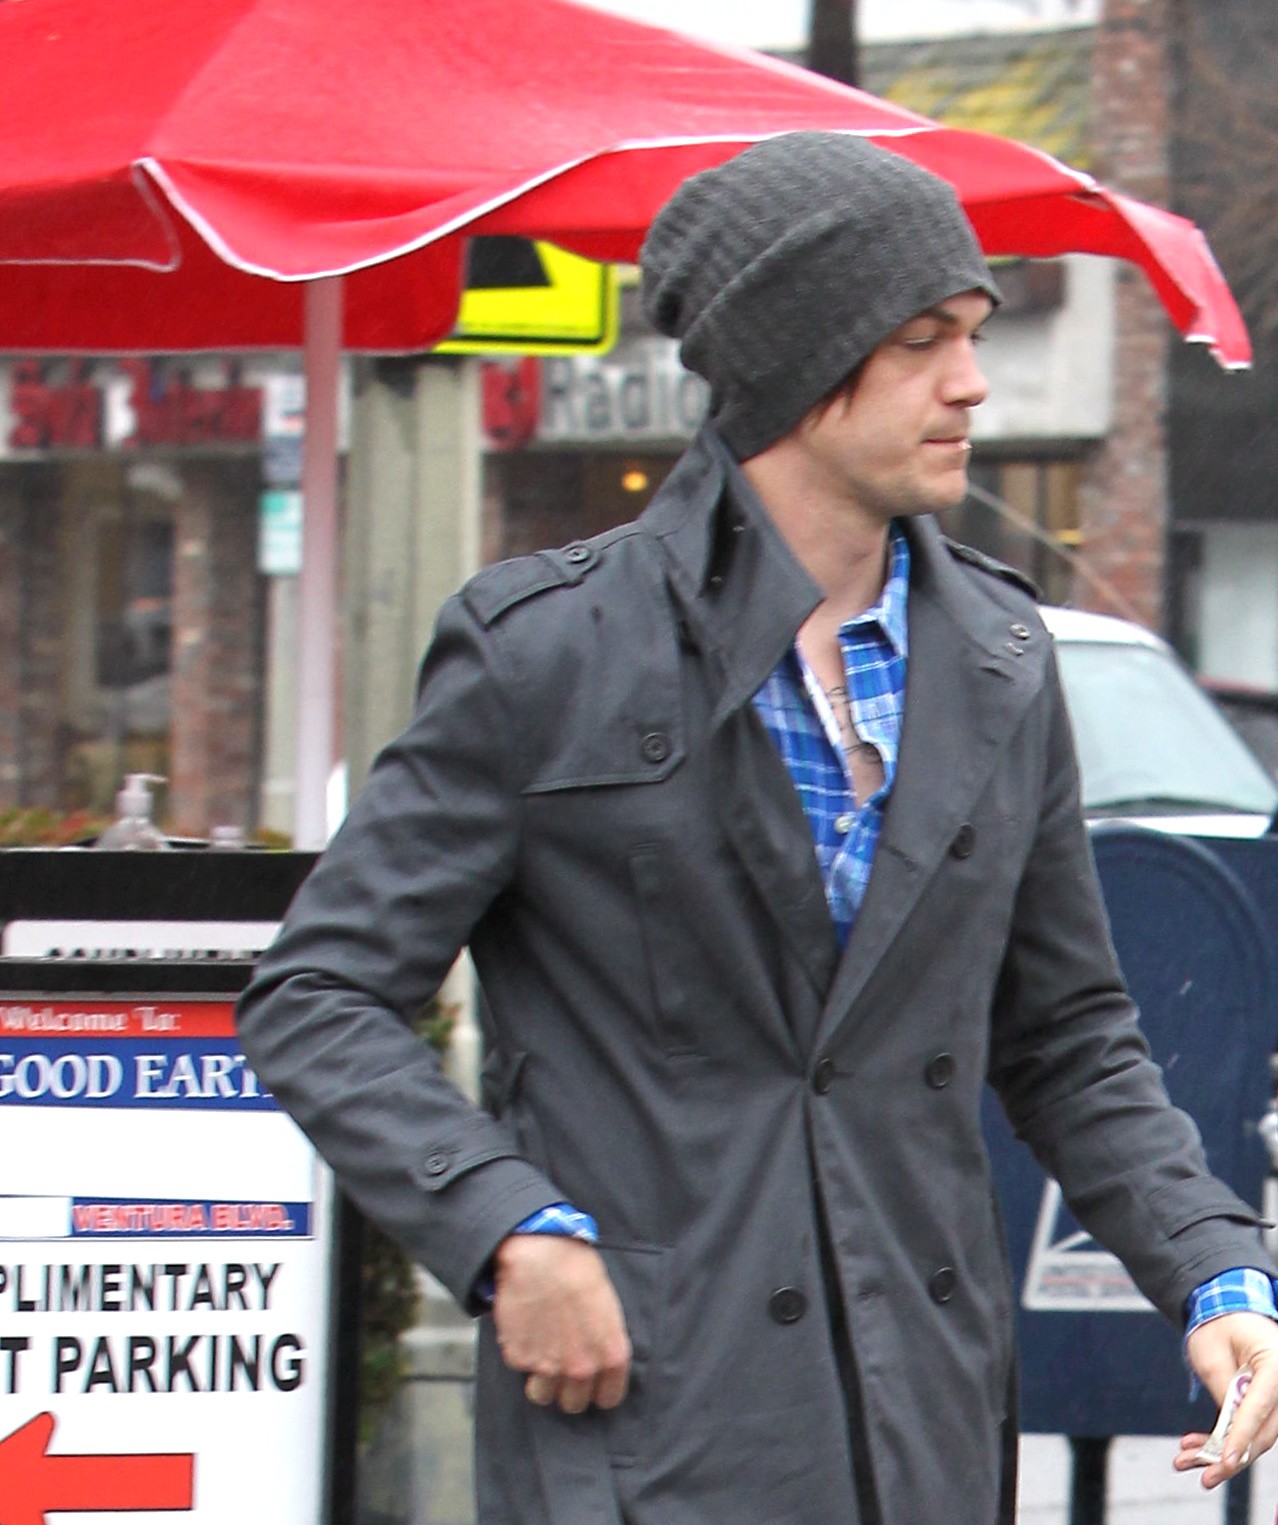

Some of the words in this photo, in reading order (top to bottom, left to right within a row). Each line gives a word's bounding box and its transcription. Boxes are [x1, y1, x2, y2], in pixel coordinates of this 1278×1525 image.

[0, 1005, 128, 1031] Welcome
[133, 1053, 274, 1098] EART
[72, 1204, 205, 1232] VENTURA
[210, 1204, 295, 1231] BLVD.
[0, 1262, 282, 1312] LIMENTARY
[53, 1333, 304, 1394] PARKING
